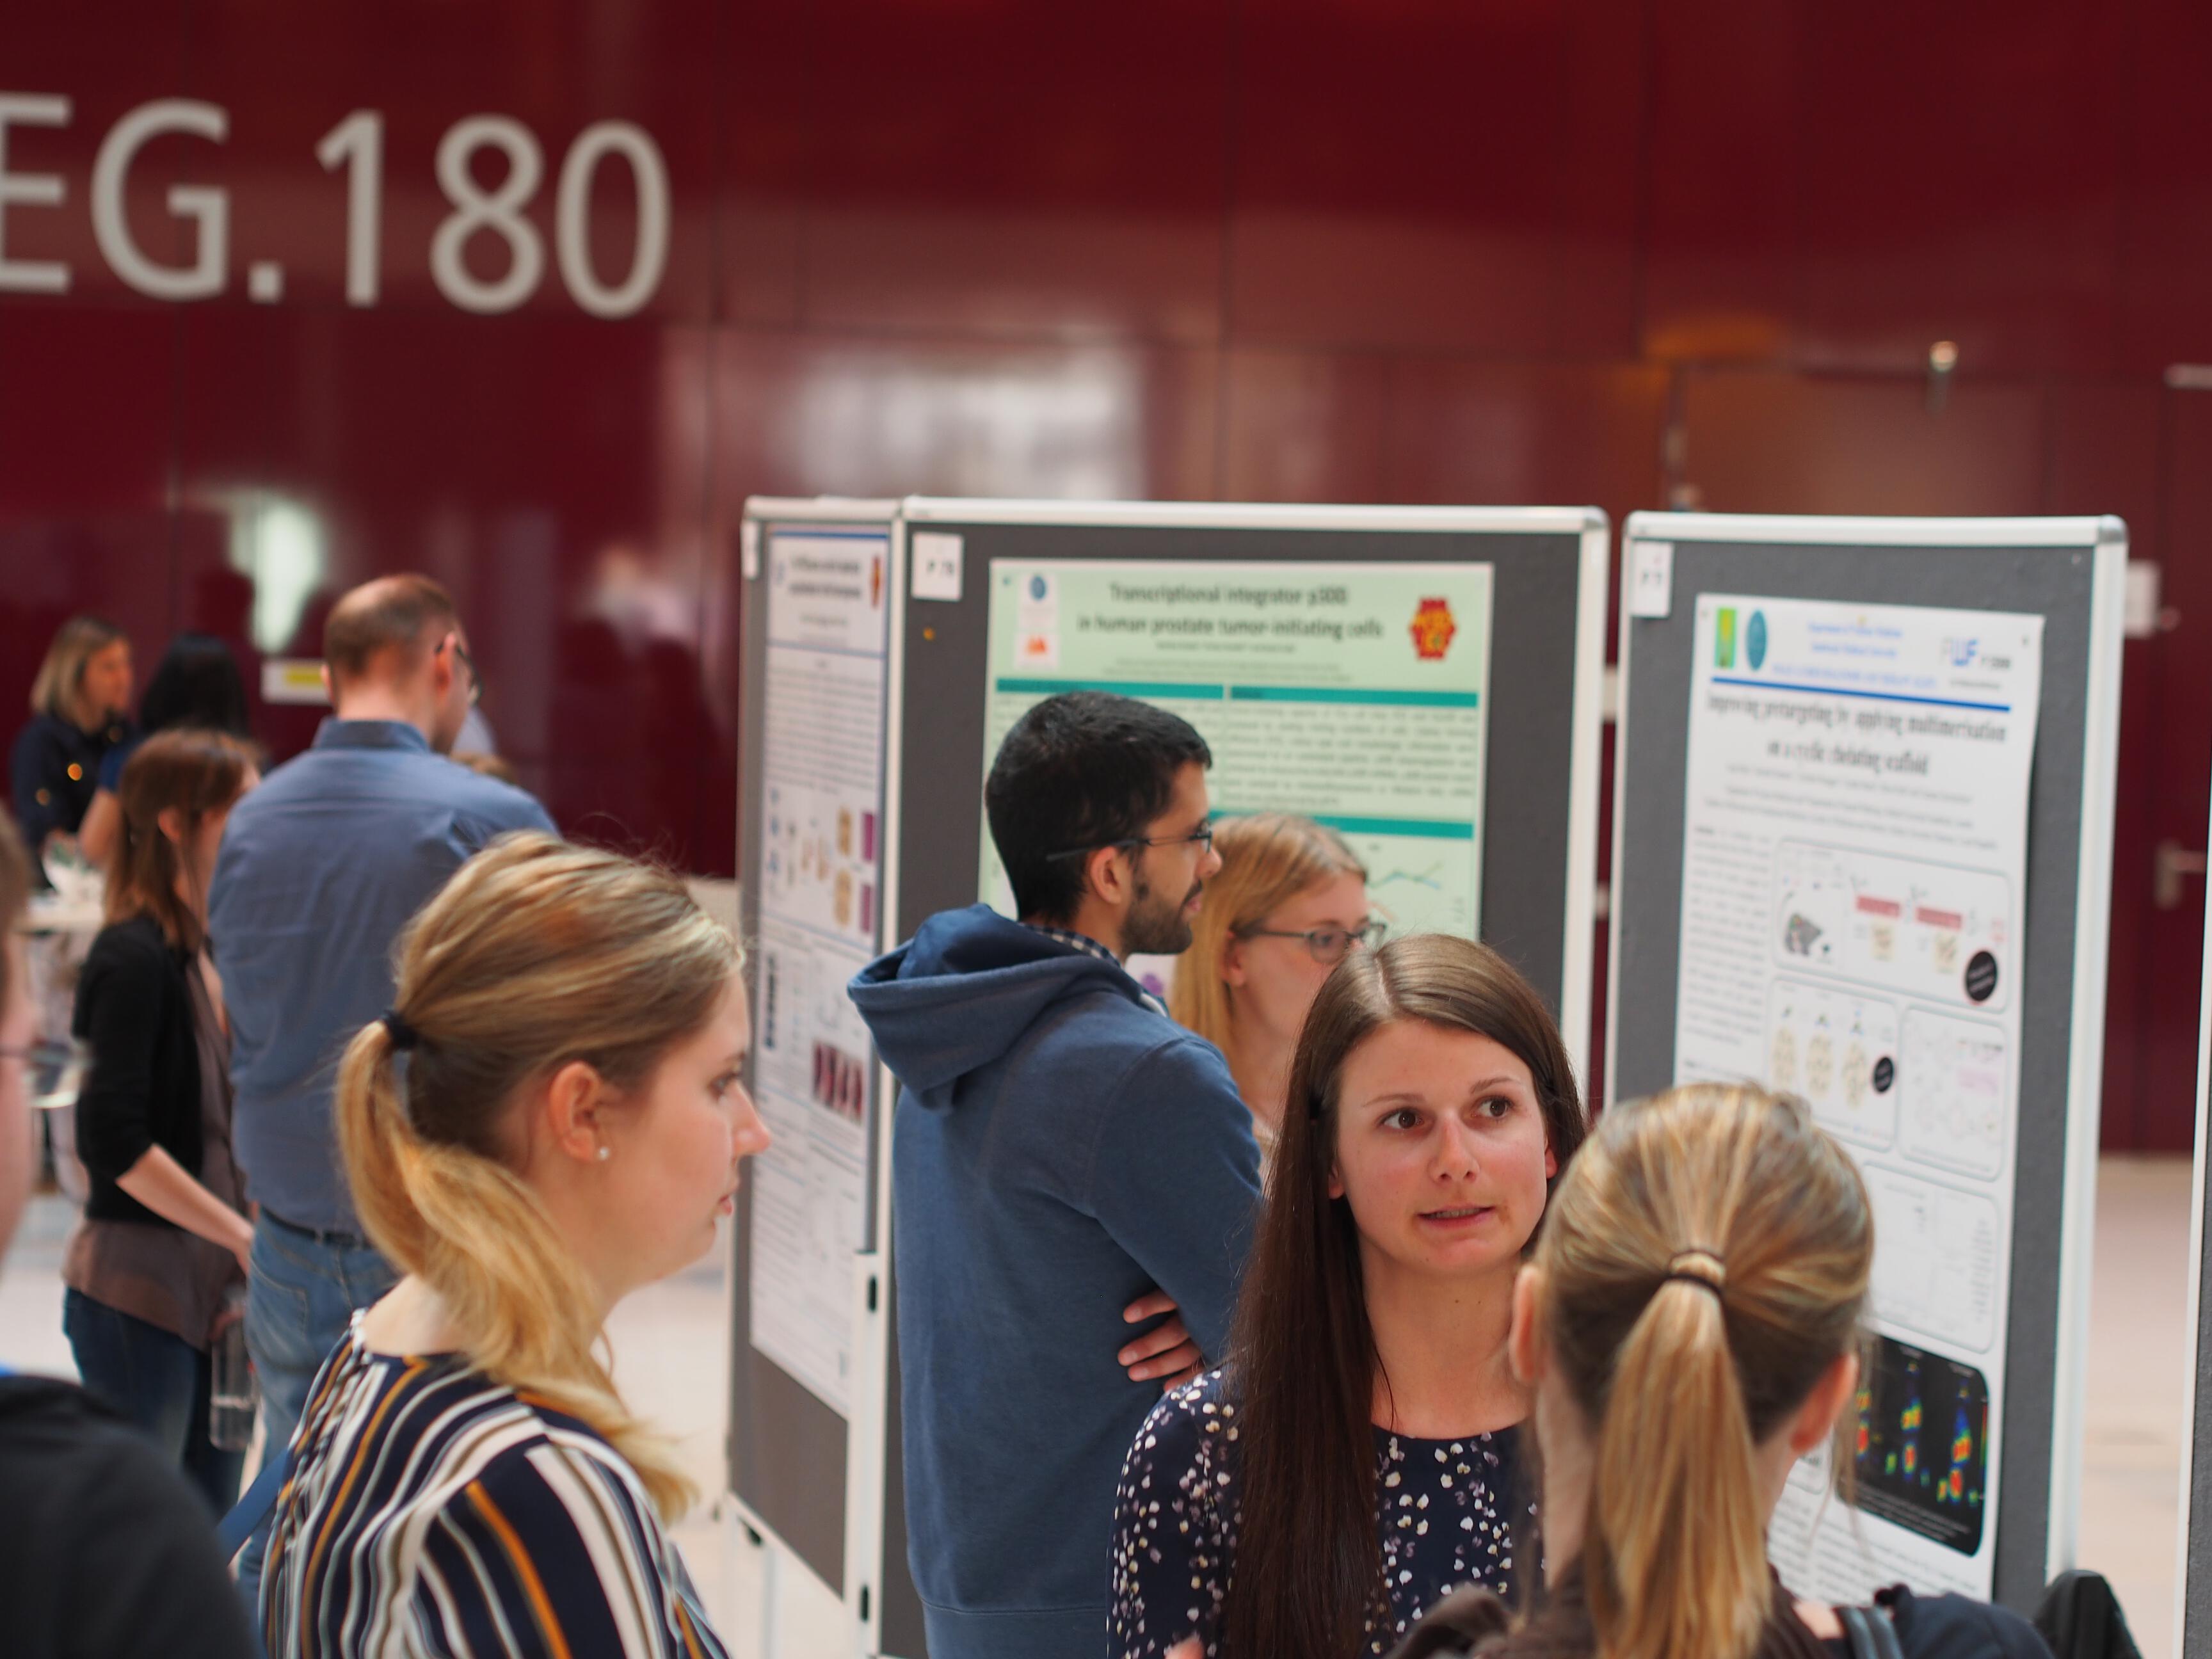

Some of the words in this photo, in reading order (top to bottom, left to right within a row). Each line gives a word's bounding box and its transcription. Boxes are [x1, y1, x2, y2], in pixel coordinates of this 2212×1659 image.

[0, 91, 672, 320] EG.180
[1109, 582, 1221, 605] Transcriptional
[1228, 585, 1302, 609] integrator
[1095, 614, 1147, 634] human
[1151, 616, 1214, 637] prostate
[1347, 618, 1384, 637] cells
